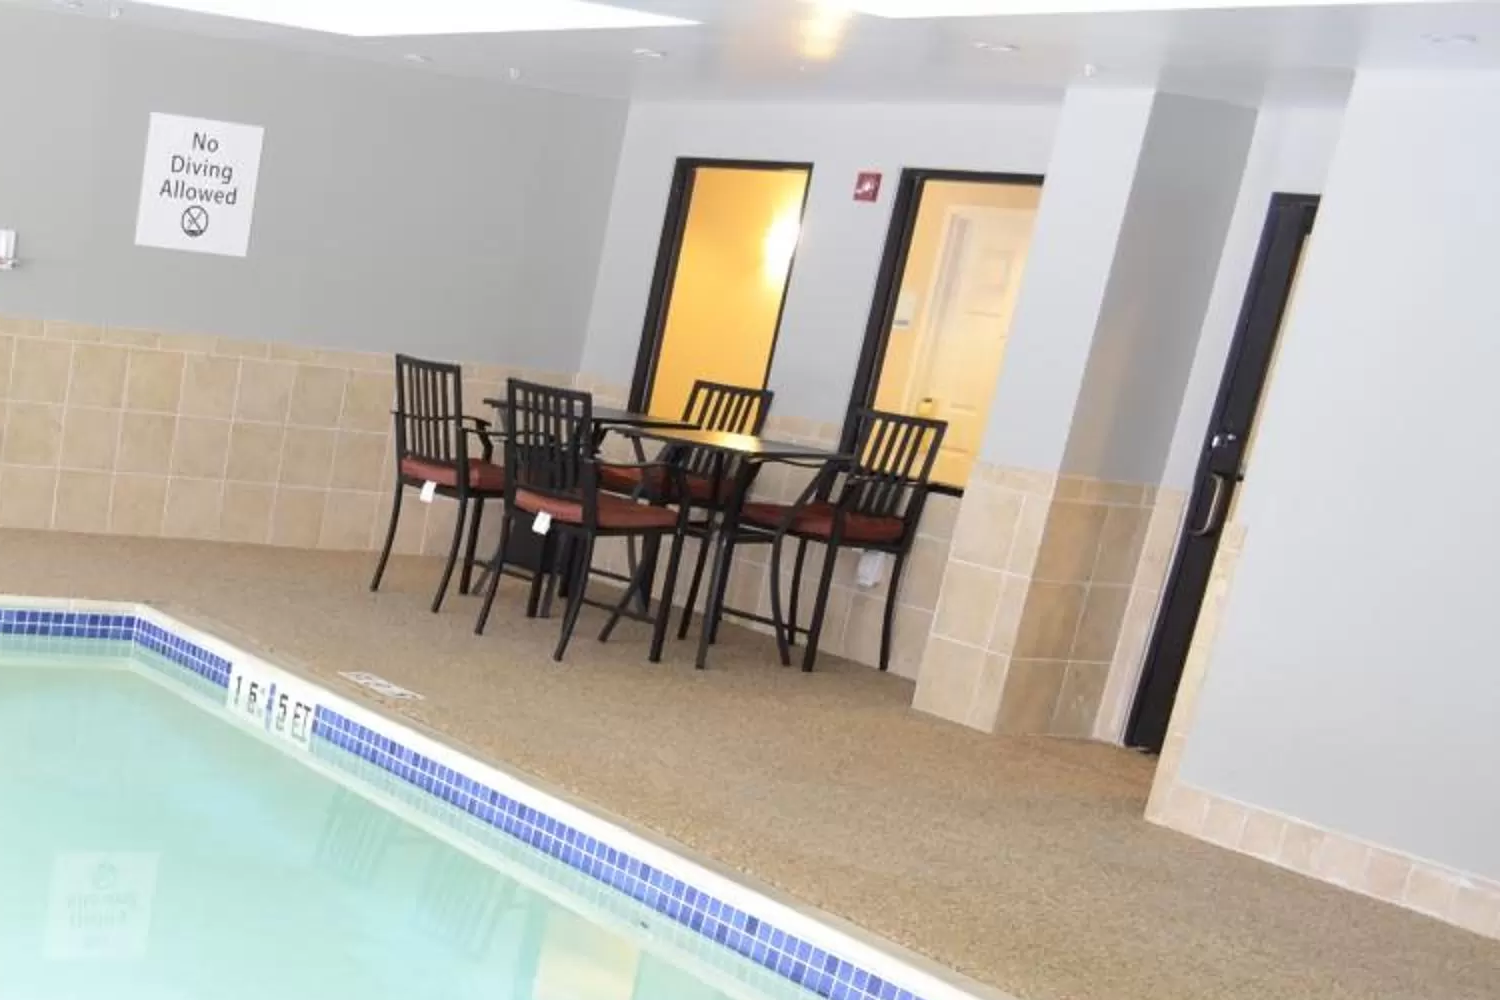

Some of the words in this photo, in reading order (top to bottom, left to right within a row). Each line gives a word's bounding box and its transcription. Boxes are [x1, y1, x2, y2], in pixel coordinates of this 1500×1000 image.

[193, 132, 219, 152] No
[171, 155, 233, 184] Diving
[159, 180, 238, 205] Allowed
